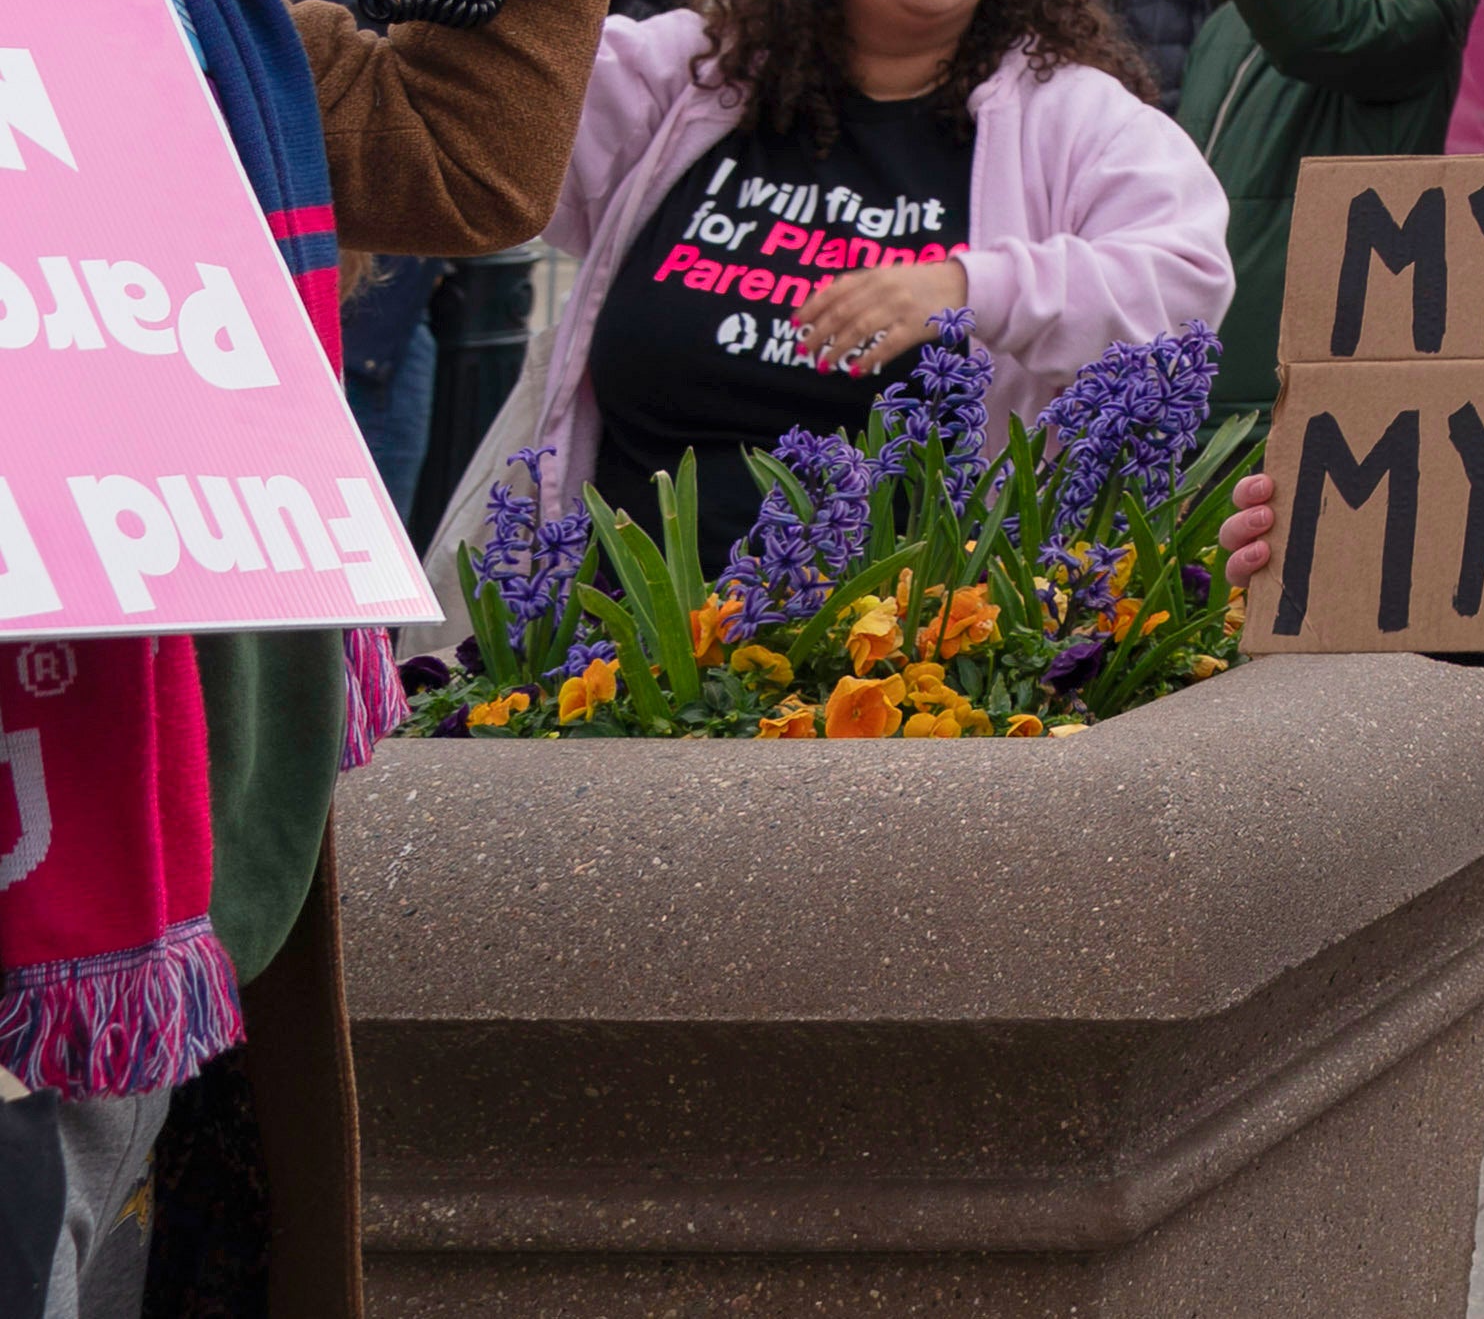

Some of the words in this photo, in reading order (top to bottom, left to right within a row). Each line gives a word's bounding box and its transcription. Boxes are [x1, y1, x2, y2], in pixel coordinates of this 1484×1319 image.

[706, 158, 737, 195] I
[738, 177, 819, 223] will
[825, 186, 945, 238] fight
[683, 201, 758, 251] for
[760, 221, 966, 270] Planne
[654, 244, 840, 307] Parent
[69, 475, 422, 614] Fund
